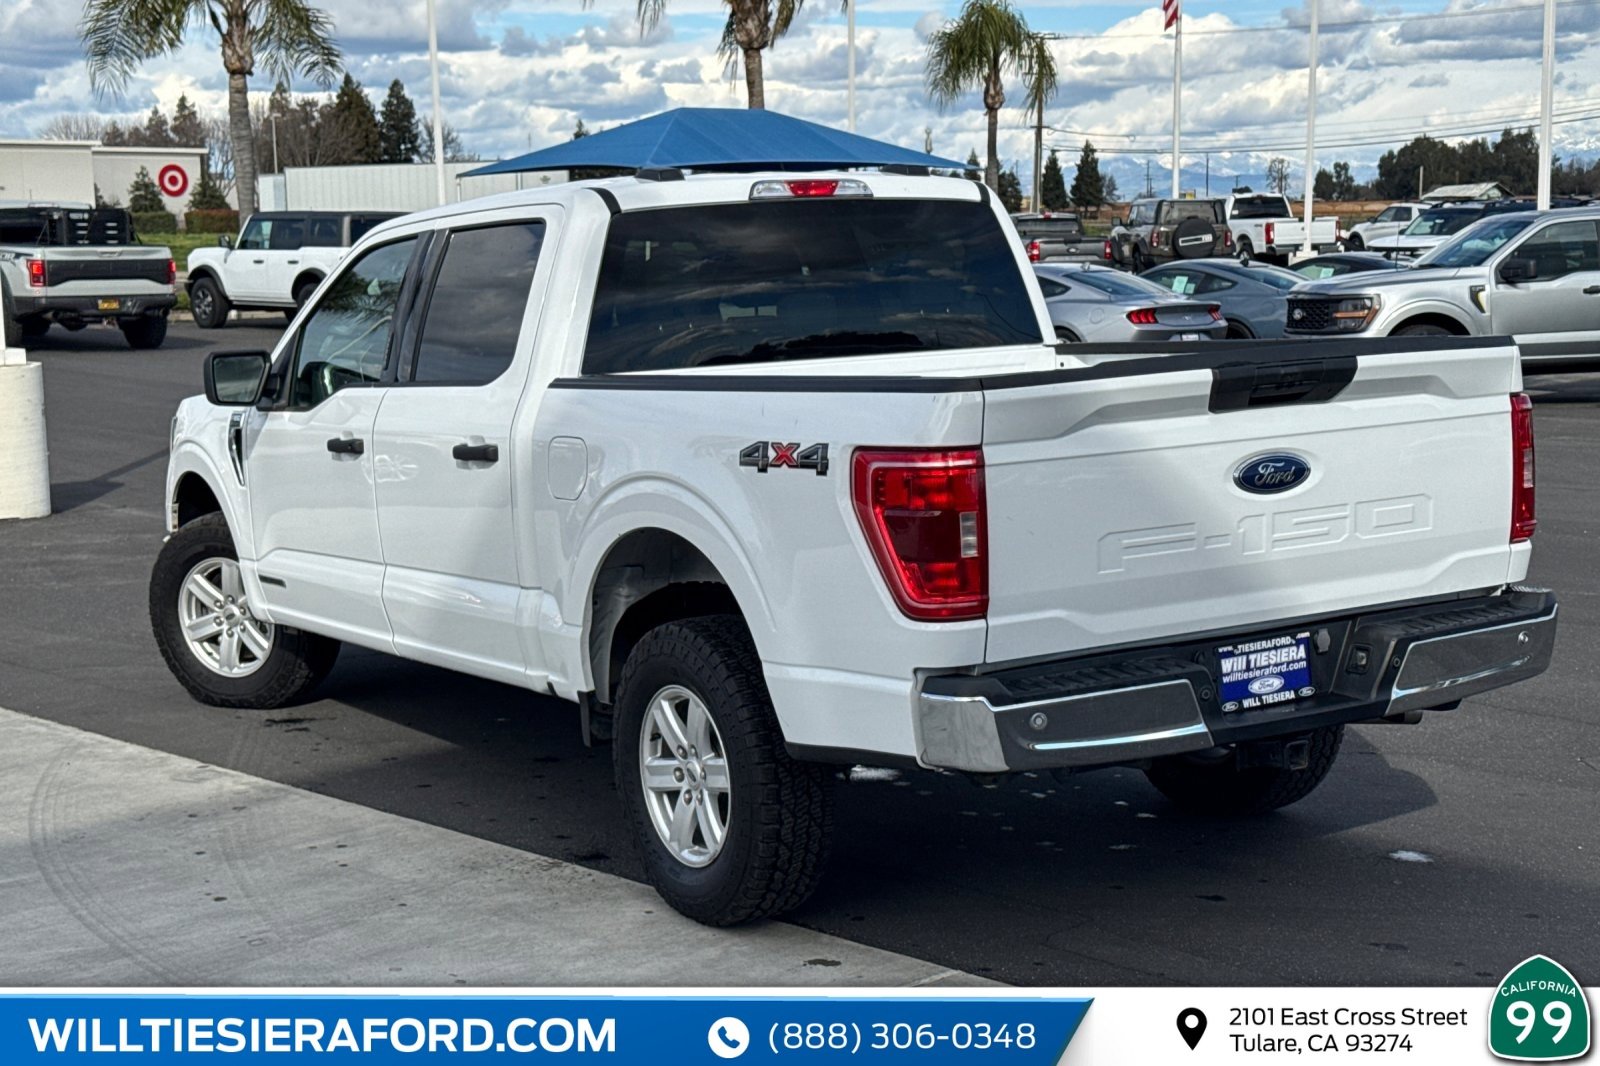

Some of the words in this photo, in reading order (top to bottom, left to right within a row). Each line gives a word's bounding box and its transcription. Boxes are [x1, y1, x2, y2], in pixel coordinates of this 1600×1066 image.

[1254, 461, 1296, 486] Ford
[1097, 493, 1433, 574] F-150
[1248, 644, 1307, 669] TIESIERA
[1222, 660, 1307, 684] willtiesieraford.com
[1242, 696, 1261, 709] WILL
[1261, 690, 1296, 705] TIESIERA
